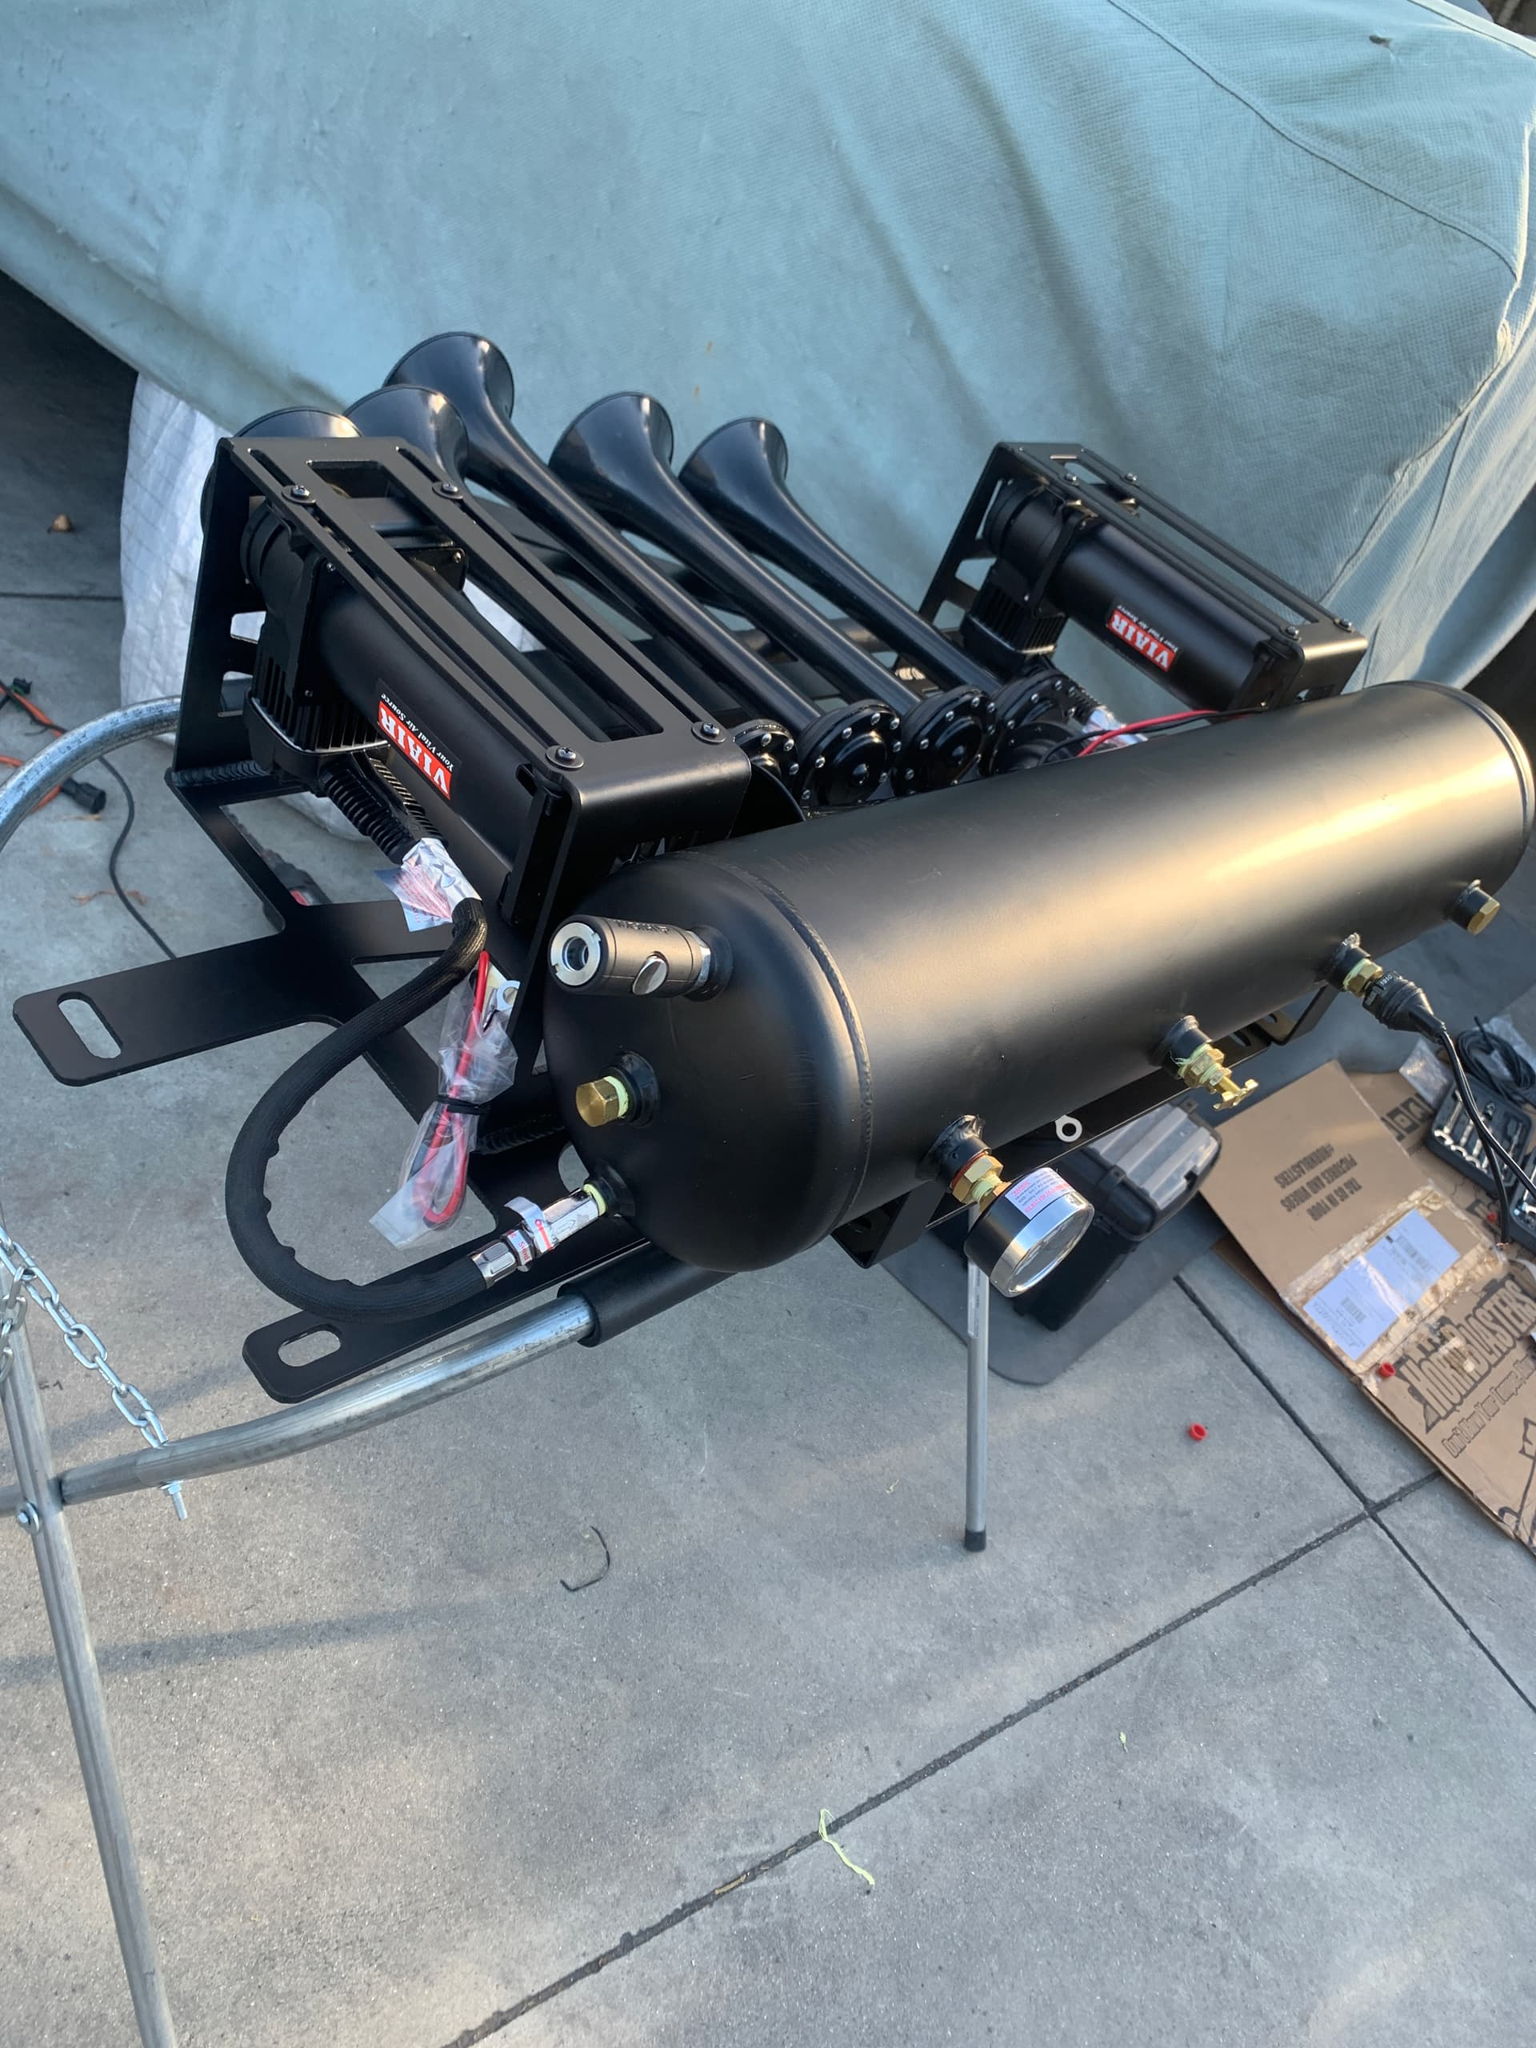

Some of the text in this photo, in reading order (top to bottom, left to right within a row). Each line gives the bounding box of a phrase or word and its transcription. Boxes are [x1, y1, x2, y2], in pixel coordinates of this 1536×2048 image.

[1111, 614, 1169, 669] VIAIR
[380, 692, 454, 772] Your Vital Air Source
[380, 706, 449, 795] VIAIR
